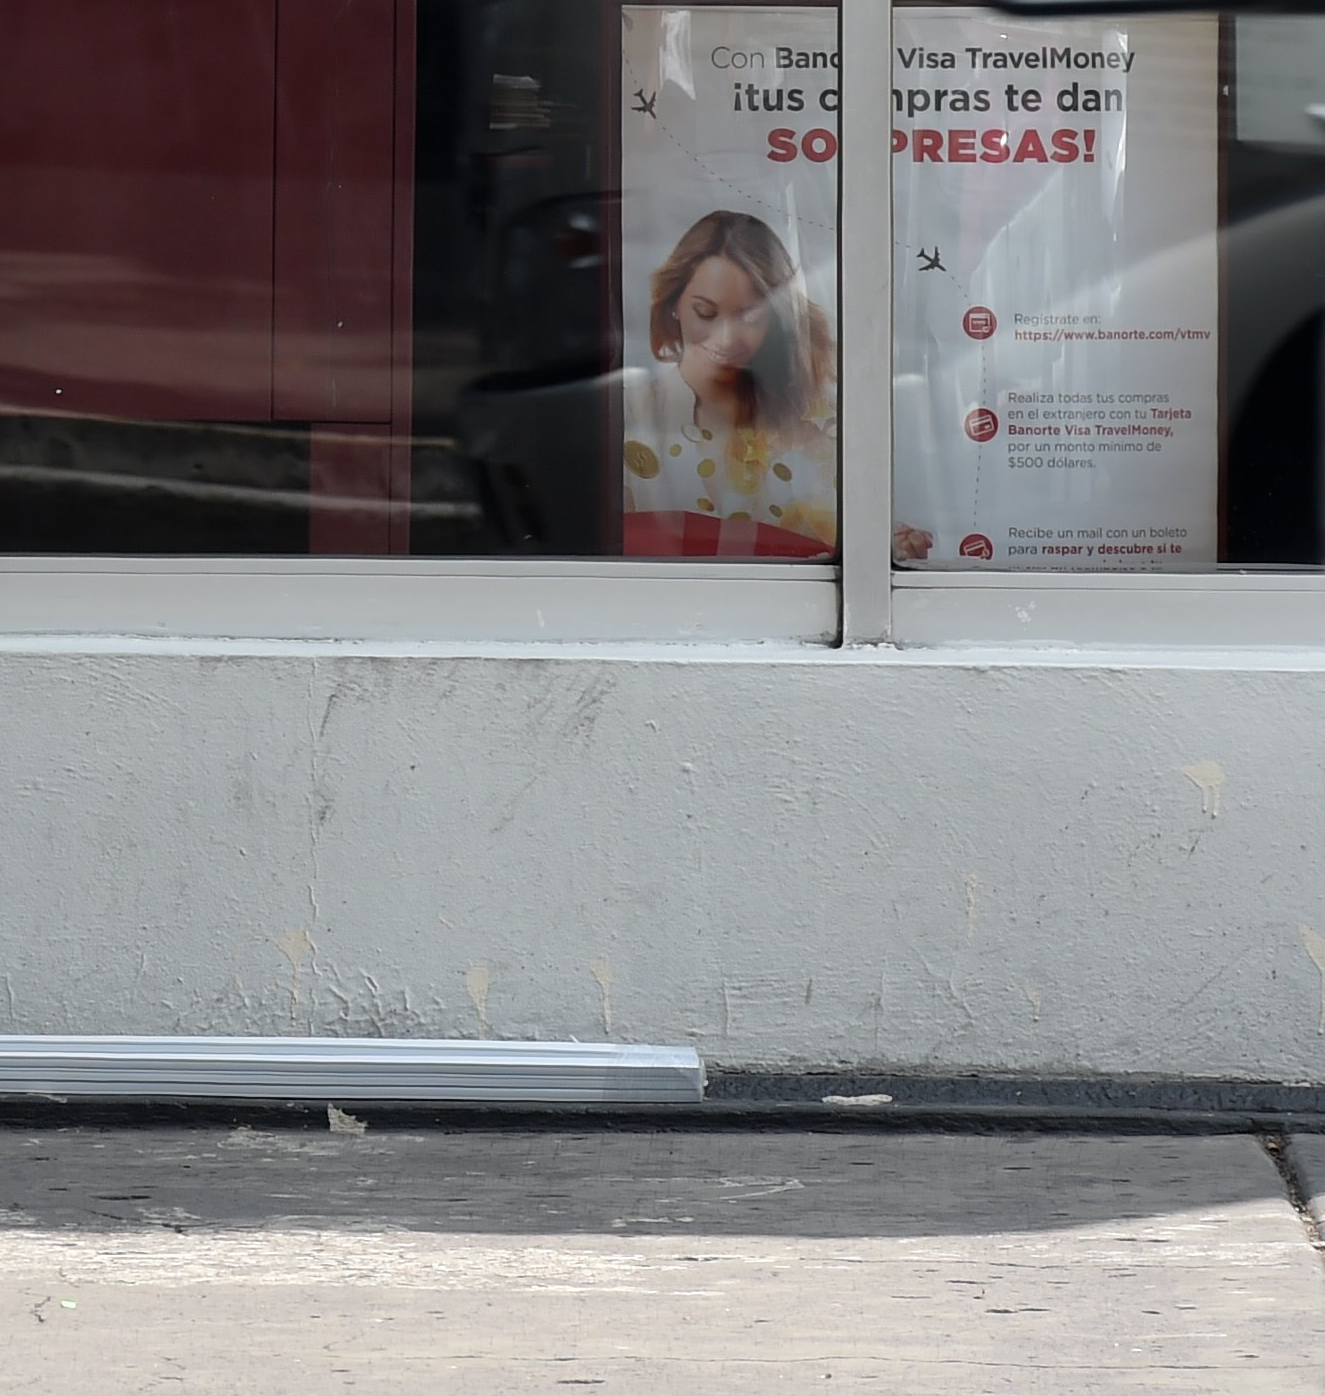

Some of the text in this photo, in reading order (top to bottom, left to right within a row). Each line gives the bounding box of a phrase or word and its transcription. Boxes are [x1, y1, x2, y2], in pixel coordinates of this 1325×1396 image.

[711, 46, 1135, 73] Con Visa TravelMoney
[1004, 86, 1042, 113] te
[1056, 82, 1123, 113] dan
[1008, 392, 1170, 404] Realiza todas tus compras
[1008, 408, 1191, 420] en el extranjero con tu Tarjeta
[1008, 424, 1173, 436] Banorte Visa TravelMoney,
[1008, 441, 1161, 453] por un monto de
[1008, 456, 1094, 468] $500 dólares.
[1009, 527, 1187, 538] Recibe un mail con un boleto
[1008, 543, 1181, 557] para raspar y descubre si te
